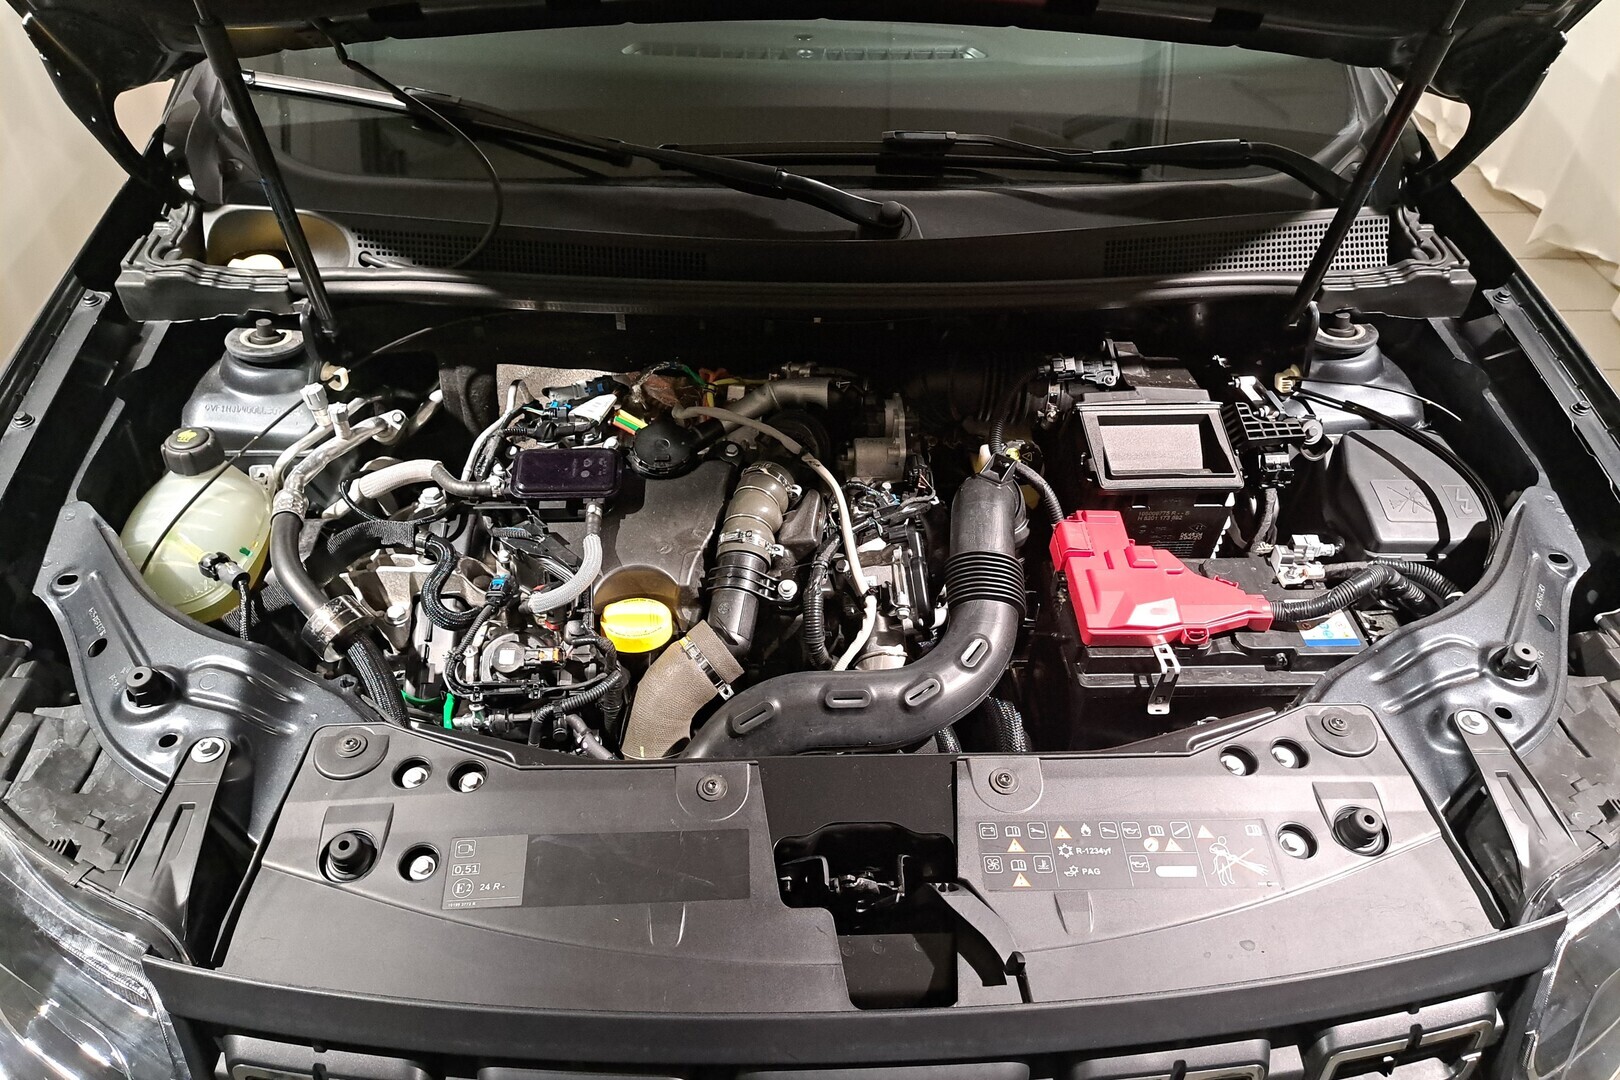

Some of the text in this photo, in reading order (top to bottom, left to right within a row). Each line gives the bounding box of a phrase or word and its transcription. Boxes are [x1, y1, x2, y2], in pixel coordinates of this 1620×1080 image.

[1075, 847, 1112, 856] R-1234yf
[454, 864, 478, 875] 0,51
[1081, 867, 1101, 875] PAG
[479, 883, 490, 891] 24
